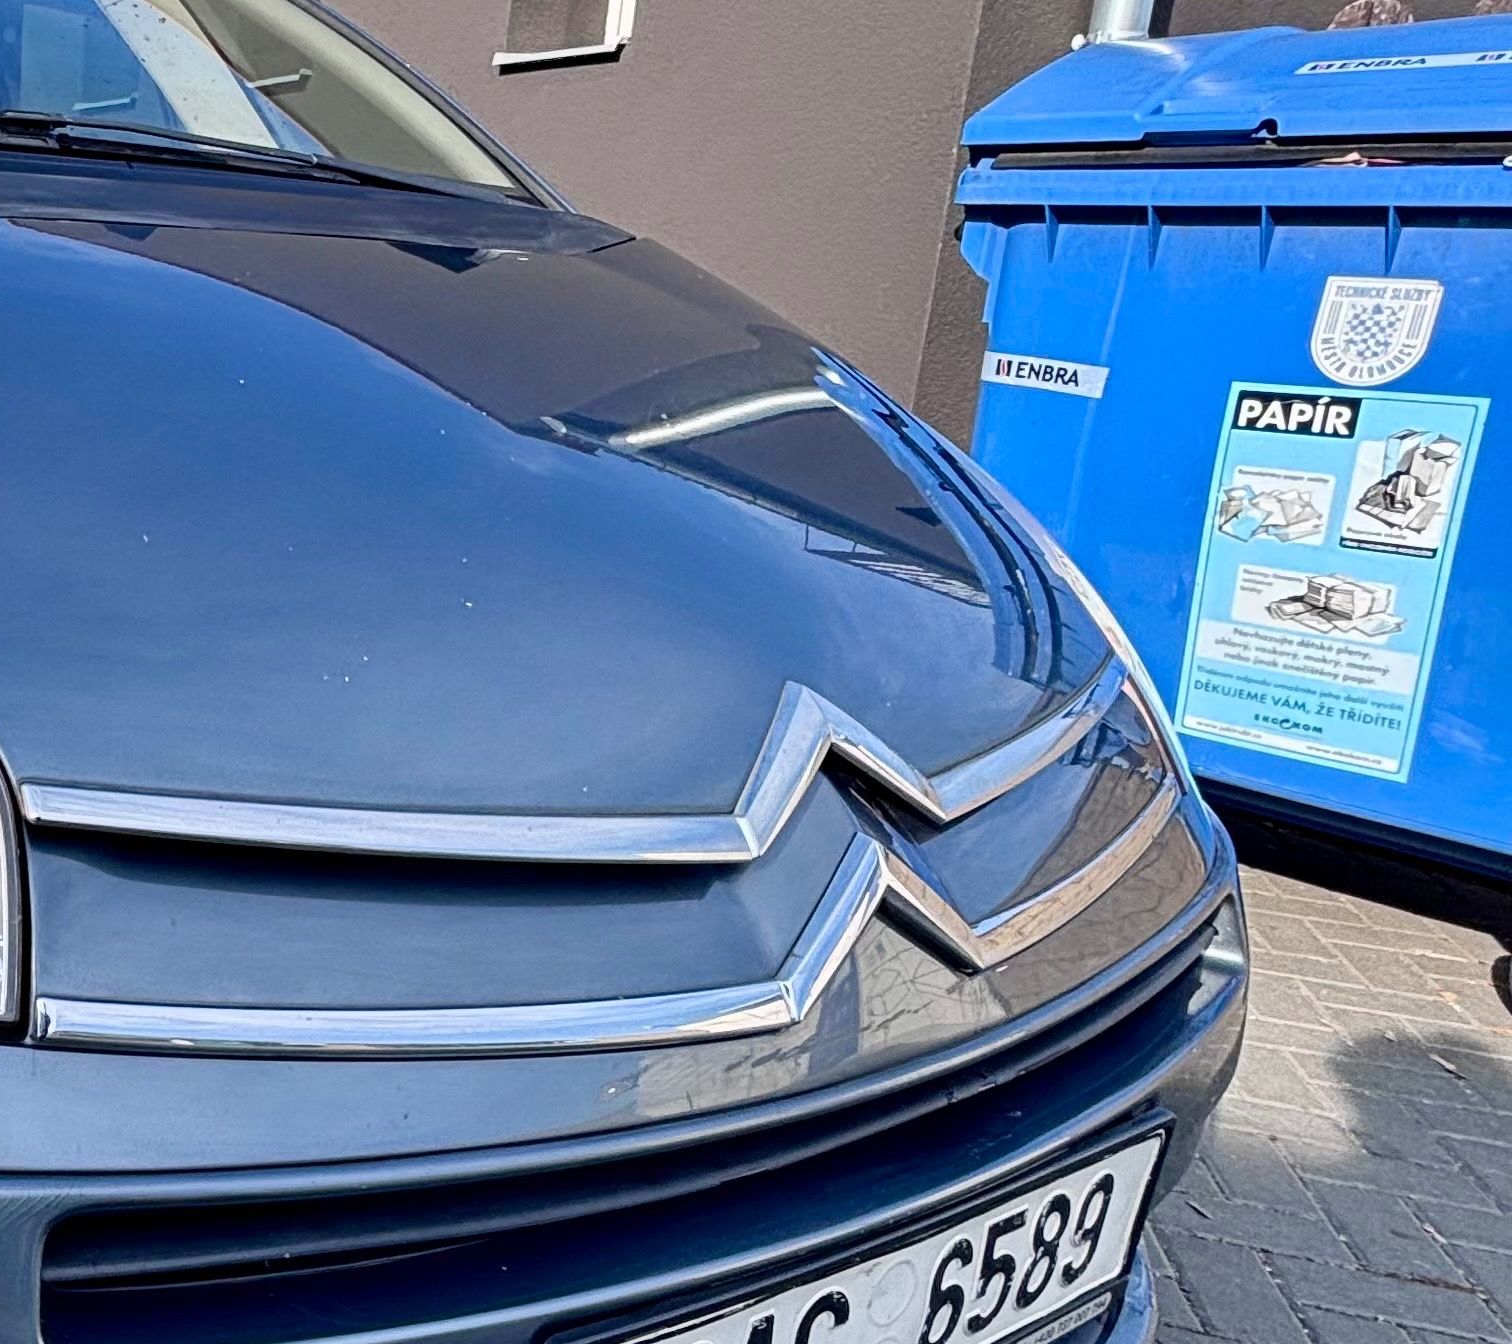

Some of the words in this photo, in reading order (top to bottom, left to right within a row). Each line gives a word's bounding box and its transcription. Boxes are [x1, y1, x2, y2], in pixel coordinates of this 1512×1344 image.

[1338, 58, 1427, 70] ENBRA
[1015, 361, 1079, 387] ENBRA
[1237, 396, 1353, 436] PAPÍR
[1194, 678, 1267, 704] DĚKUJEME
[1271, 693, 1311, 715] VÁM,
[1315, 702, 1334, 717] ŽE
[1339, 707, 1402, 731] TŘÍDÍTE!
